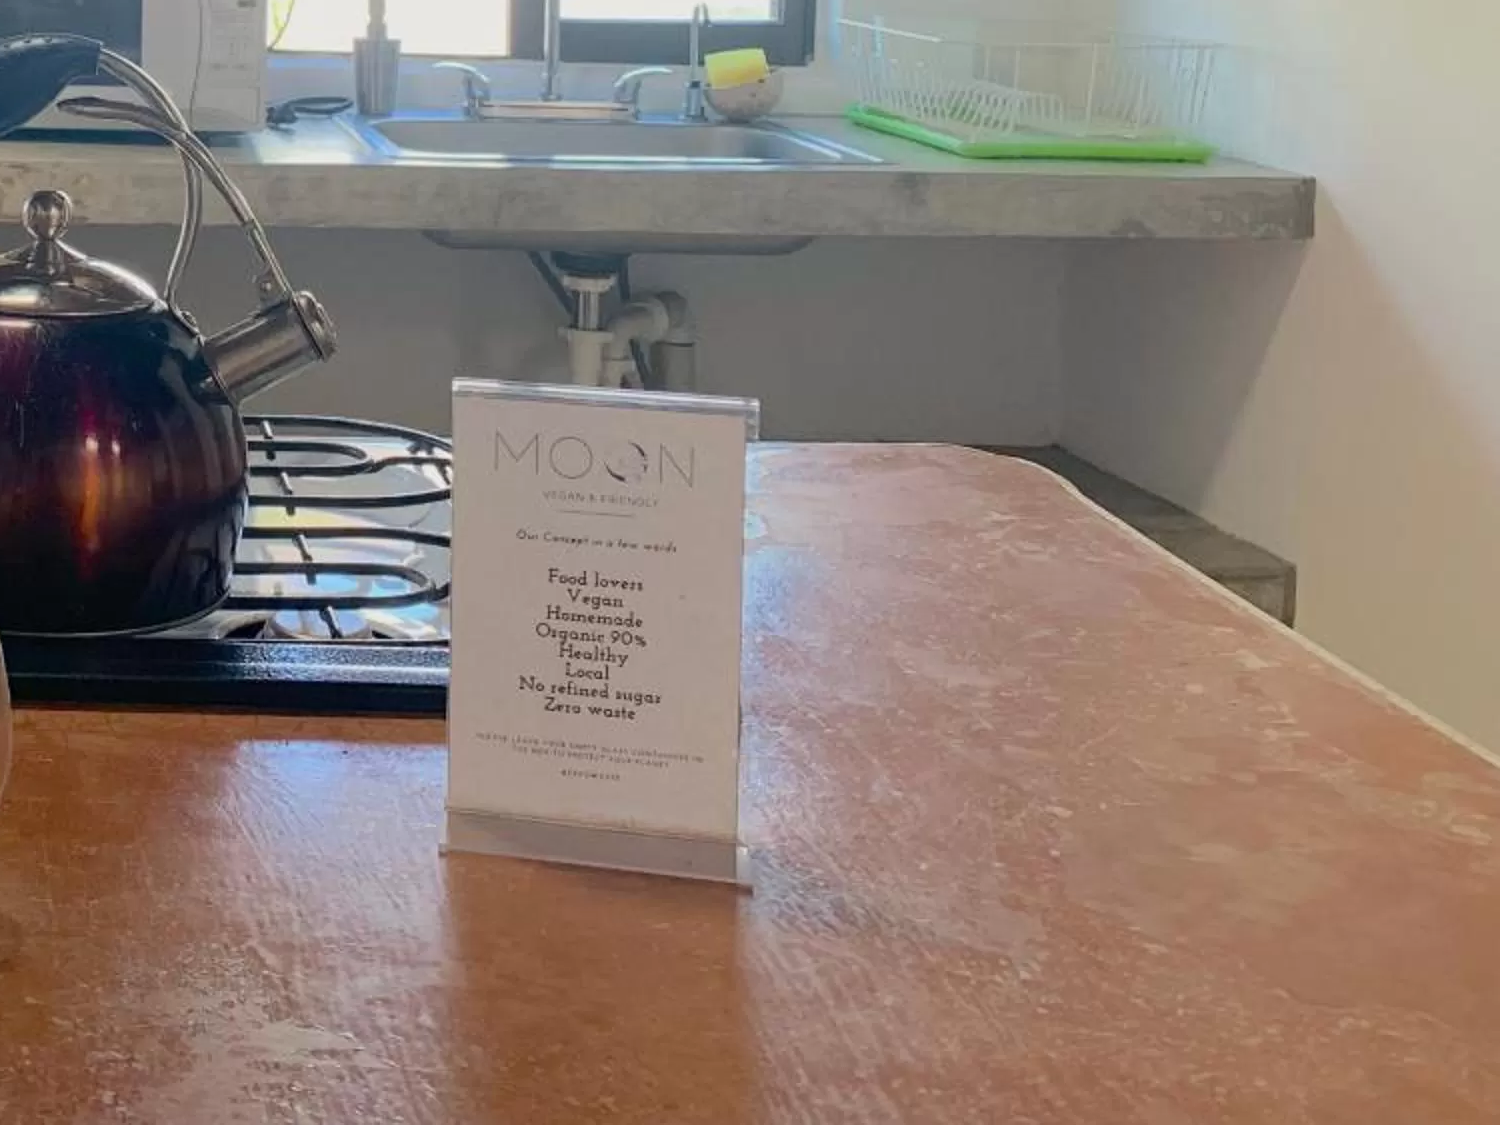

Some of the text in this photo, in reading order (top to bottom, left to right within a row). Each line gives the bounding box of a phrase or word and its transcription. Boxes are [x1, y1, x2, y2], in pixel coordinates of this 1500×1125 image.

[548, 568, 644, 592] Food lovers
[567, 588, 624, 610] Vegan
[546, 605, 644, 628] Homemade
[535, 622, 647, 647] Organic 90%
[558, 642, 629, 667] Healthy
[565, 662, 610, 681] Local
[518, 674, 662, 707] No refined sugar
[543, 696, 637, 720] Zero waste
